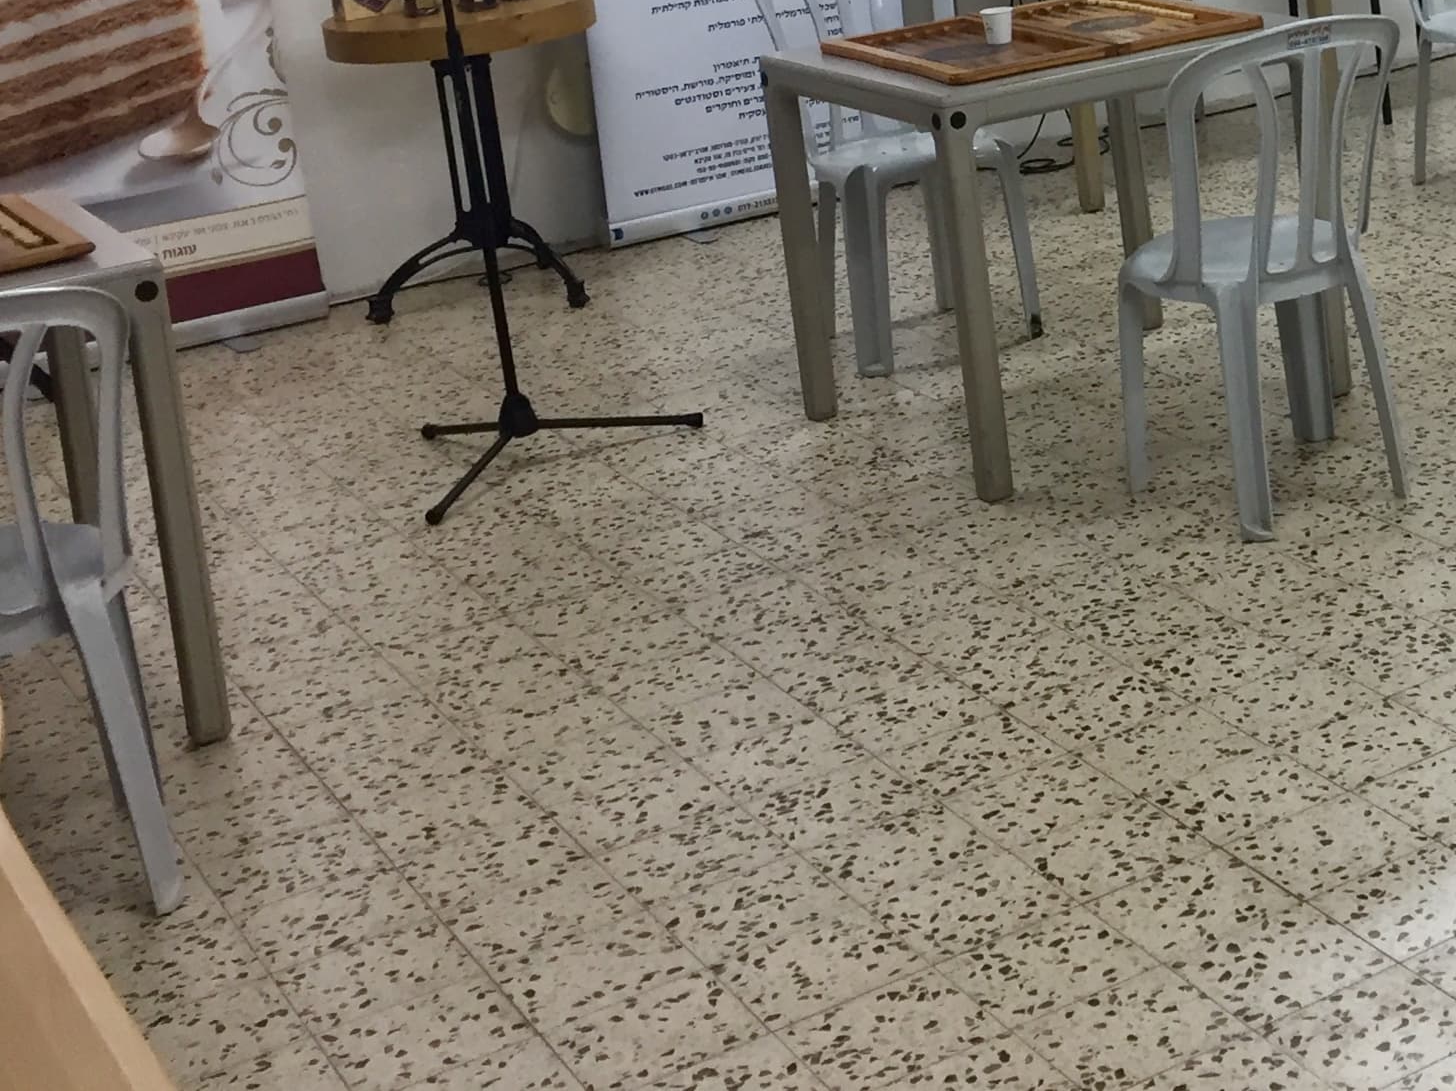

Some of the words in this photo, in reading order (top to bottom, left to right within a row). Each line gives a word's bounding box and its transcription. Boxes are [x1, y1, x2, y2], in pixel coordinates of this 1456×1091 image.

[651, 0, 692, 15] קהילתית
[707, 18, 746, 32] פורמלית
[713, 57, 750, 73] תיאטרון
[634, 85, 679, 100] היסטוריה
[674, 89, 723, 106] וסטודנטים
[725, 84, 756, 96] צעירים
[705, 99, 742, 113] וחוקרים
[162, 243, 197, 260] עוגות
